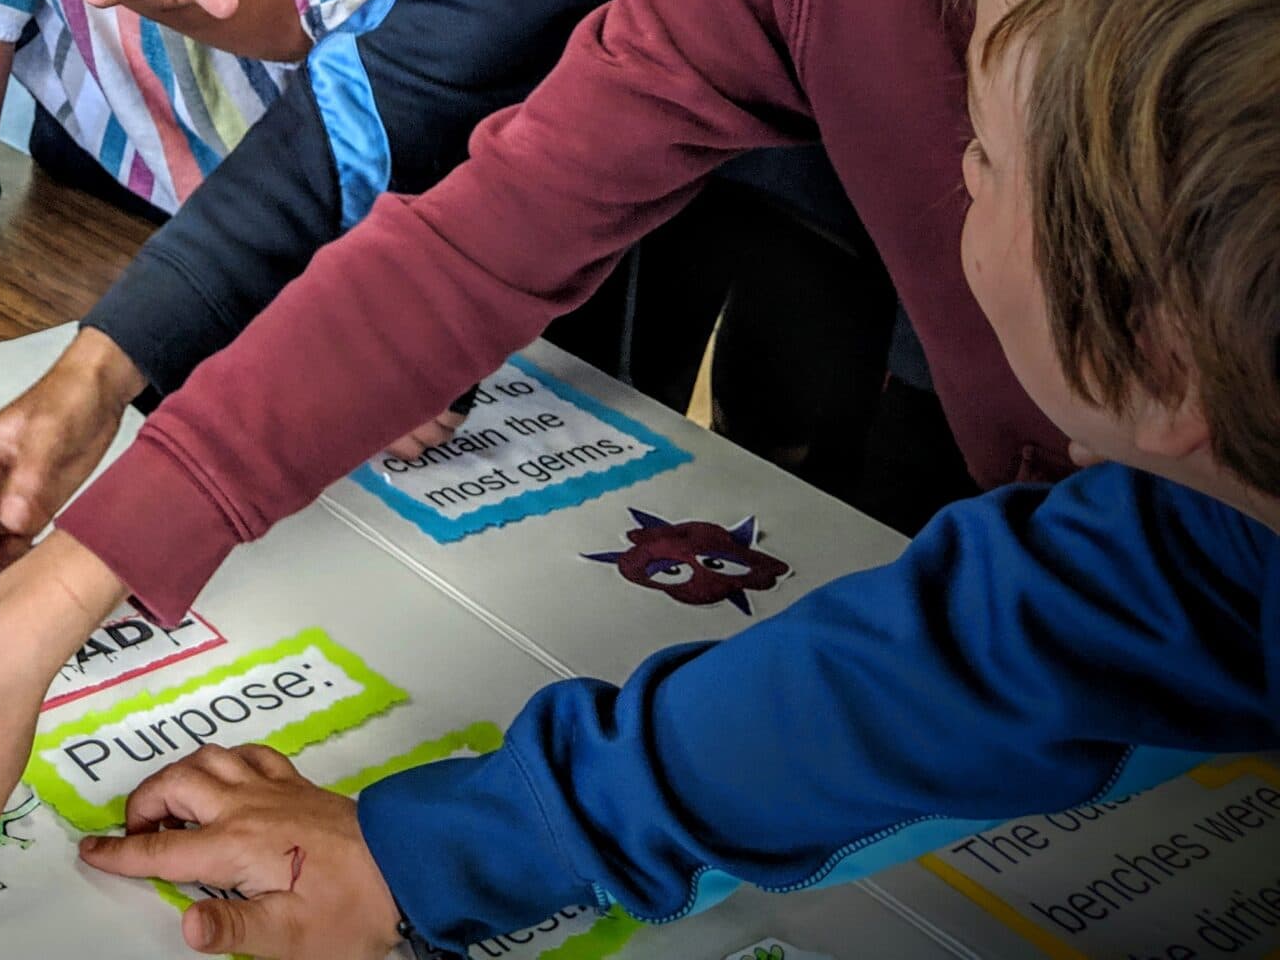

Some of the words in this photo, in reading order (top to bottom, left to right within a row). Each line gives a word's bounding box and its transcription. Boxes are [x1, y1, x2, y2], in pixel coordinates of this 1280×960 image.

[495, 379, 535, 399] to
[504, 411, 565, 437] the
[425, 467, 520, 507] most
[517, 437, 634, 483] germs.
[64, 663, 334, 783] Purpose:
[951, 824, 1050, 873] The
[1029, 833, 1210, 933] benches
[1194, 876, 1280, 953] dirtie
